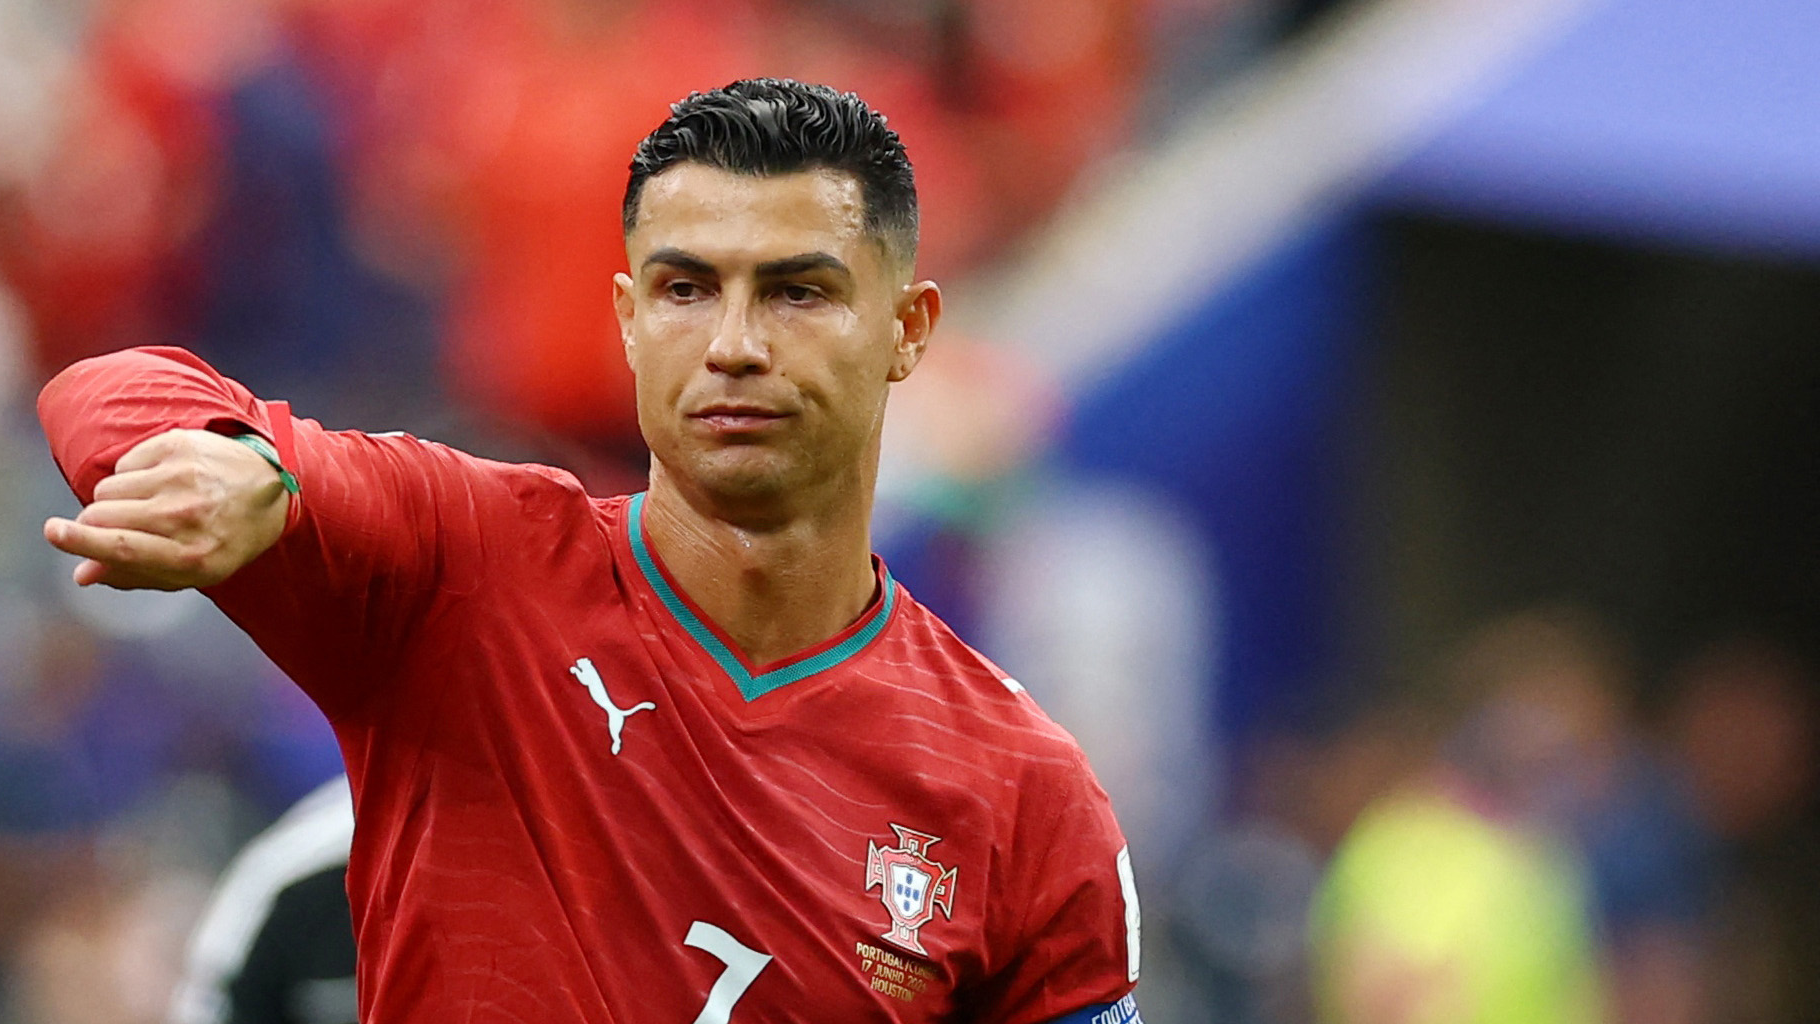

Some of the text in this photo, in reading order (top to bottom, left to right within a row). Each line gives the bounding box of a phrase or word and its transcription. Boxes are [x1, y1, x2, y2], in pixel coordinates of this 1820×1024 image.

[861, 959, 873, 972] 17
[874, 963, 904, 984] JUNHO
[871, 976, 915, 1002] HOUSTON
